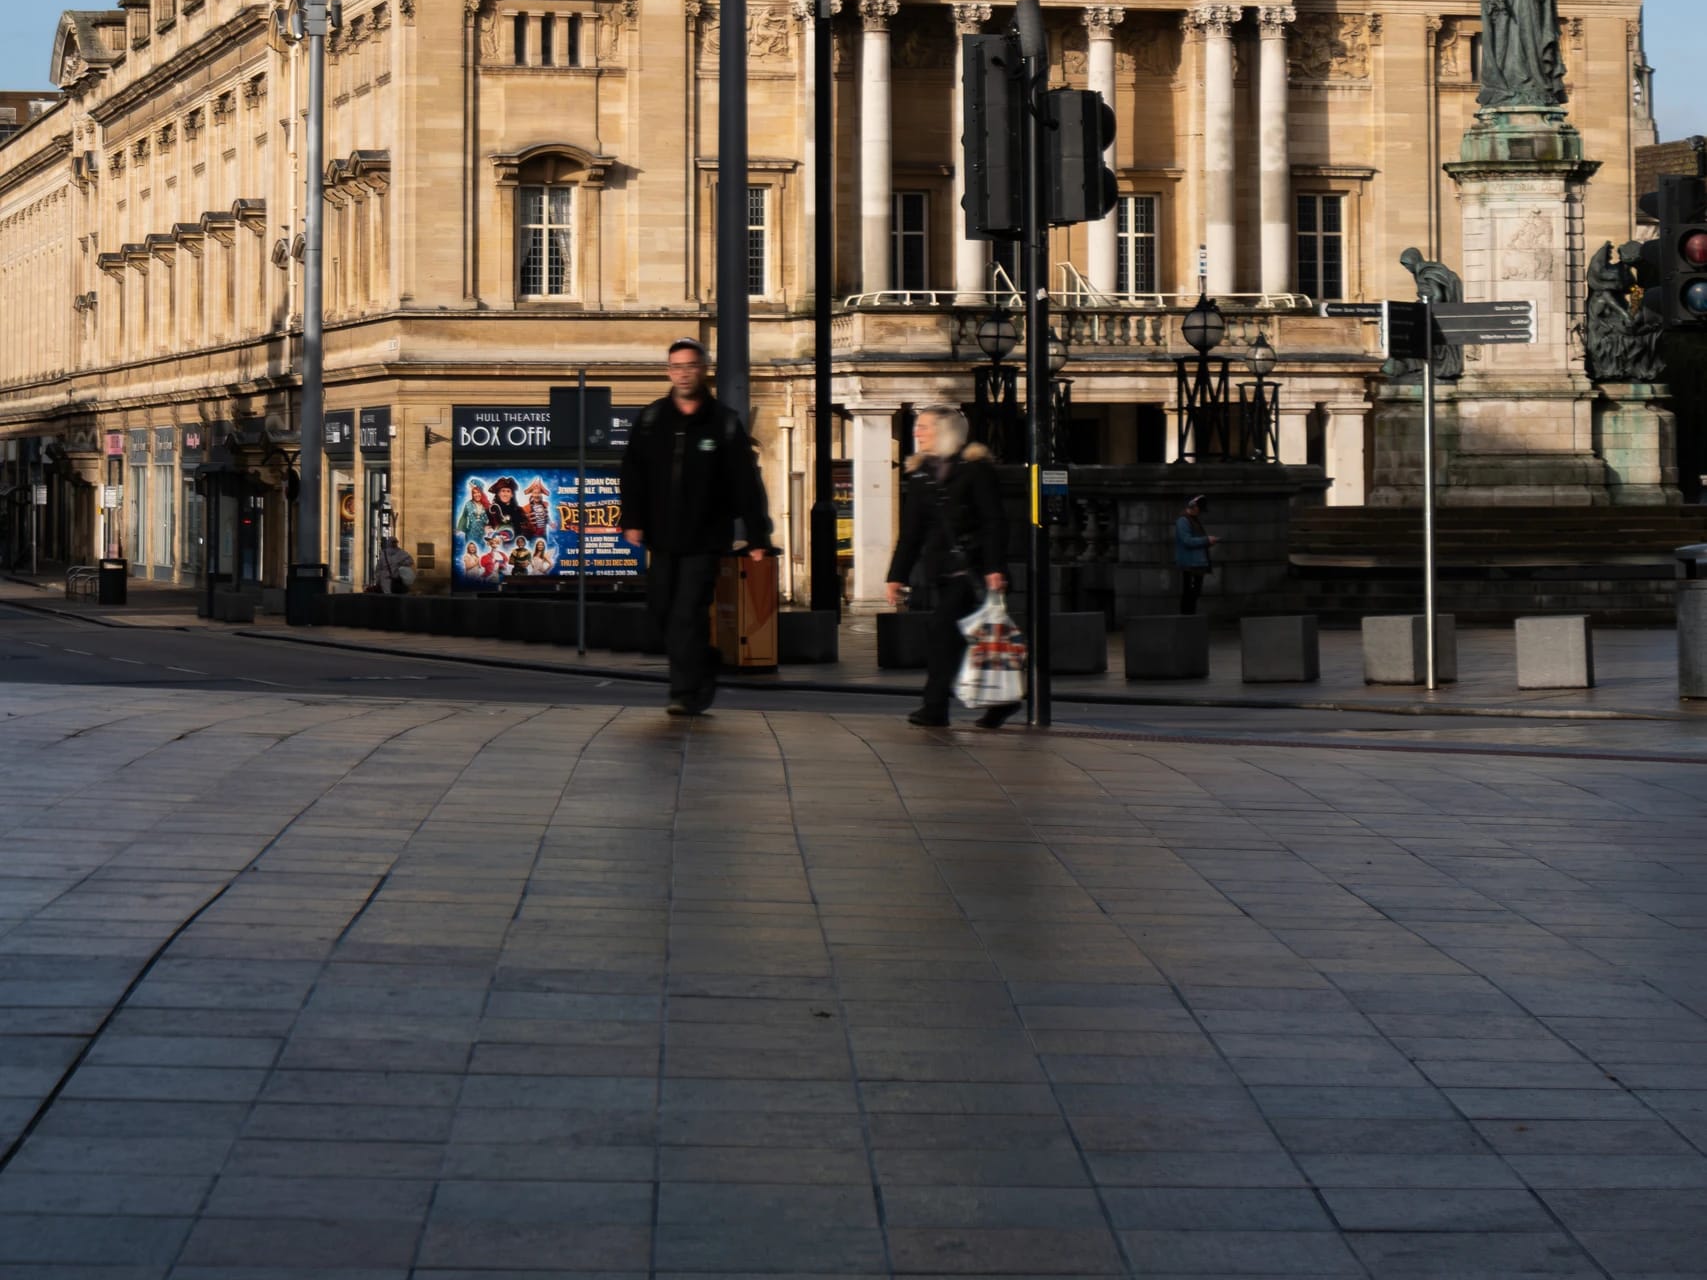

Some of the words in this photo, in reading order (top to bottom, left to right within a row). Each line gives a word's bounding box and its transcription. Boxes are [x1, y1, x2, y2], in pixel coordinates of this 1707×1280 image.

[476, 413, 501, 422] HULL
[504, 413, 551, 422] THEATRES
[460, 426, 501, 446] BOX
